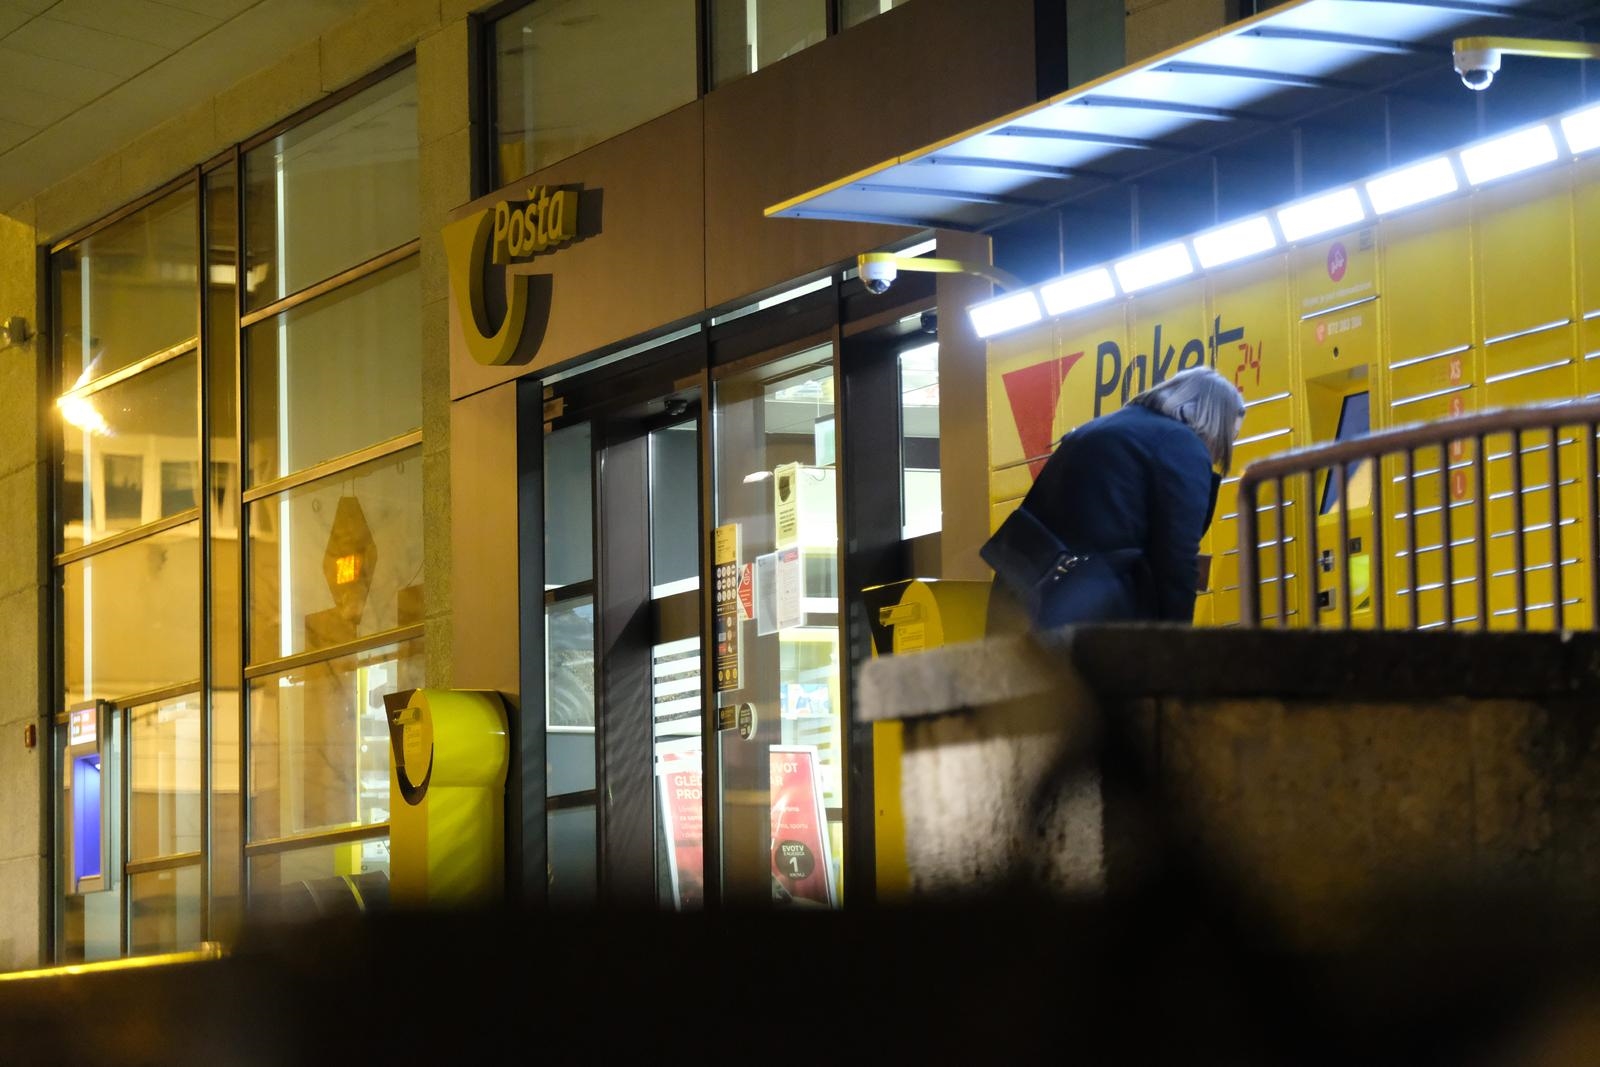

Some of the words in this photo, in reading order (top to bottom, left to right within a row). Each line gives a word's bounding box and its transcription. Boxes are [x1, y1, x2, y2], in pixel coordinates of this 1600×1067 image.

[492, 184, 567, 265] Pošta
[1094, 315, 1244, 418] Paket
[676, 788, 702, 800] PRO
[789, 856, 799, 871] 1
